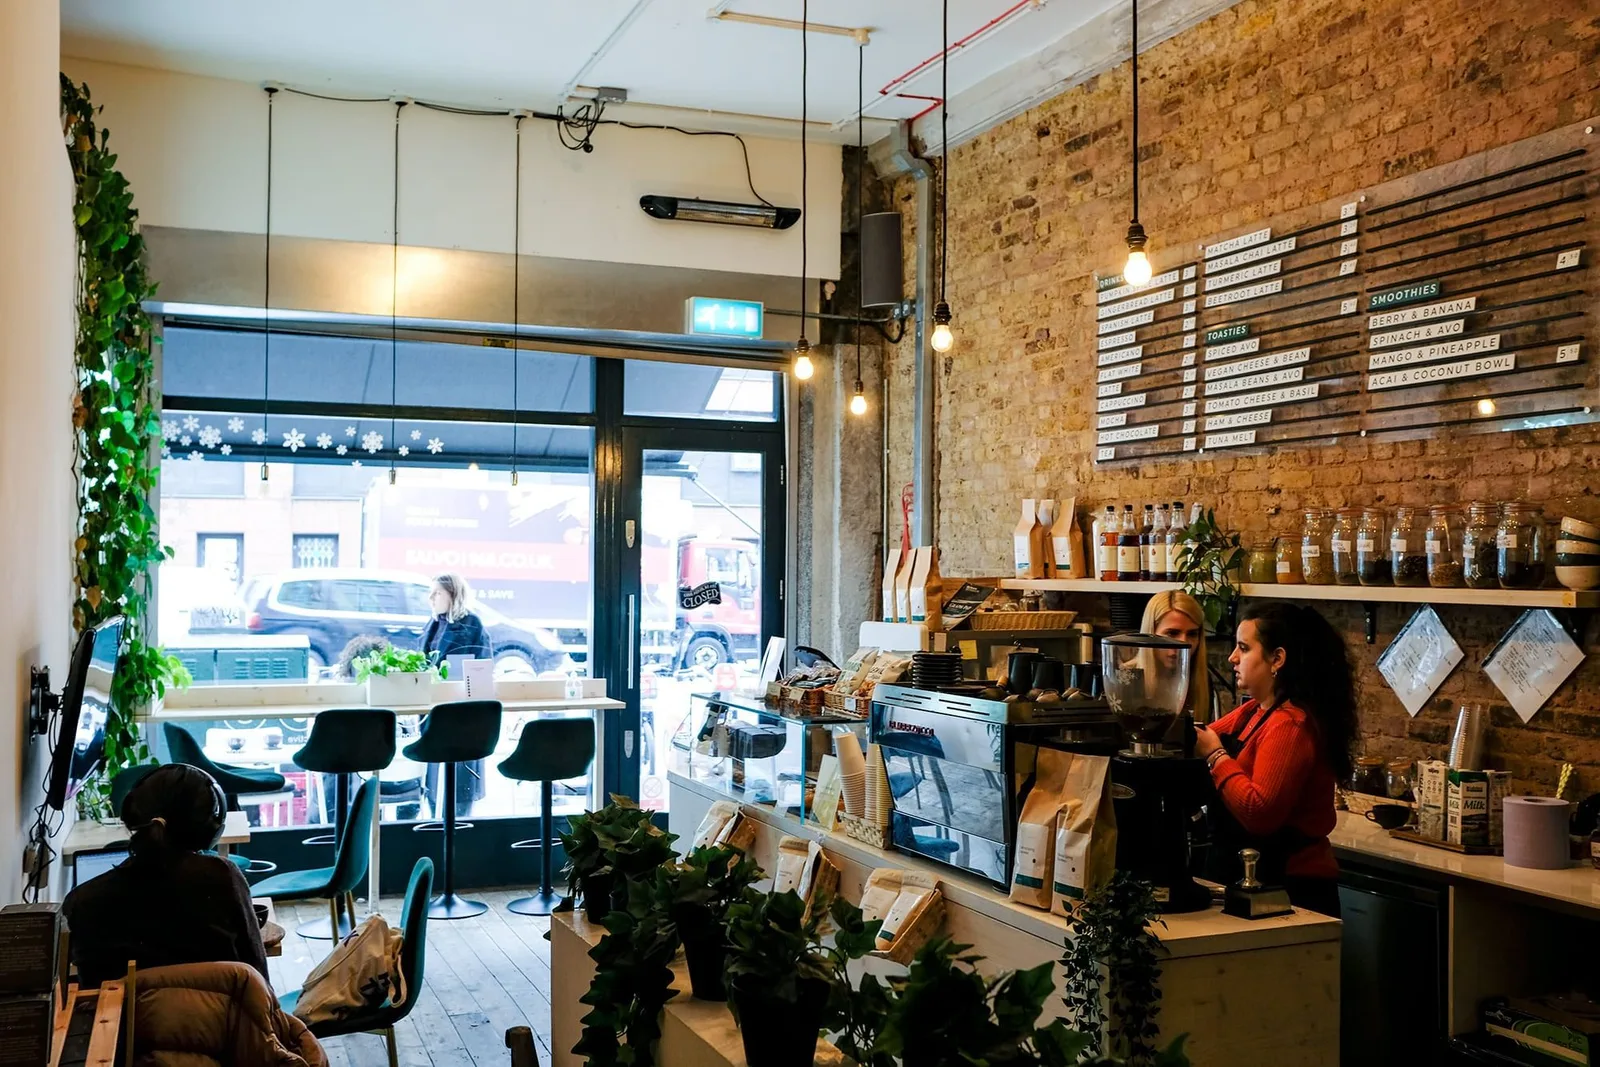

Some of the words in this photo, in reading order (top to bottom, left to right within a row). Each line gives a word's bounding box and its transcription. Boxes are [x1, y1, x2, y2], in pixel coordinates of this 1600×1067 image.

[1208, 240, 1239, 255] MATCHA
[1243, 231, 1269, 245] LATTE
[1208, 256, 1239, 270] MASALA
[1243, 249, 1263, 261] CHAI
[1267, 240, 1293, 254] LATTE
[1208, 272, 1248, 287] TURMERIC
[1252, 262, 1278, 276] LATTE
[1100, 287, 1130, 300] PUMPKIN
[1155, 273, 1176, 285] LATTE
[1208, 291, 1250, 305] BEETROOT
[1254, 282, 1280, 295] LATTE
[1371, 283, 1437, 305] SMOOTHIES
[1100, 298, 1149, 316] GINGERBREAD
[1150, 291, 1172, 303] LATTE
[1372, 313, 1406, 327] BERRY
[1411, 310, 1417, 319] &
[1424, 300, 1472, 317] BANANA
[1101, 320, 1128, 331] SPANISH
[1132, 313, 1152, 324] LATTE
[1101, 334, 1133, 345] ESPRESSO
[1208, 325, 1246, 340] TOASTIES
[1373, 331, 1420, 346] SPINACH
[1425, 328, 1432, 337] &
[1437, 323, 1460, 334] AVO
[1101, 349, 1140, 361] AMERICANO
[1208, 345, 1236, 358] SPICED
[1241, 341, 1256, 350] AVO
[1372, 352, 1412, 366] MANGO
[1417, 350, 1424, 359] &
[1429, 338, 1496, 357] PINEAPPLE
[1100, 370, 1115, 378] FLAT
[1118, 365, 1139, 375] WHITE
[1208, 365, 1234, 377] VEGAN
[1238, 358, 1270, 371] CHEESE
[1273, 356, 1279, 364] &
[1283, 351, 1307, 362] BEAN
[1371, 376, 1397, 386] ACAI
[1401, 373, 1408, 382] &
[1413, 364, 1470, 380] COCONUT
[1476, 357, 1510, 371] BOWL
[1101, 384, 1119, 394] LATTE
[1208, 381, 1238, 391] MASALA
[1242, 376, 1269, 386] BEANS
[1273, 374, 1278, 382] &
[1283, 370, 1300, 380] AVO
[1100, 395, 1144, 409] CAPPUCCINO
[1208, 398, 1240, 410] TOMATO
[1244, 392, 1276, 404] CHEESE
[1280, 391, 1285, 399] &
[1290, 386, 1316, 398] BASIL
[1100, 416, 1123, 425] MOCHA
[1208, 418, 1225, 427] HAM
[1228, 417, 1233, 425] &
[1236, 411, 1269, 424] CHEESE
[1100, 433, 1113, 441] HOT
[1116, 427, 1157, 439] CHOCOLATE
[1208, 436, 1229, 444] TUNA
[1232, 432, 1253, 442] MELT
[683, 588, 718, 608] CLOSED
[1464, 800, 1485, 809] Milk
